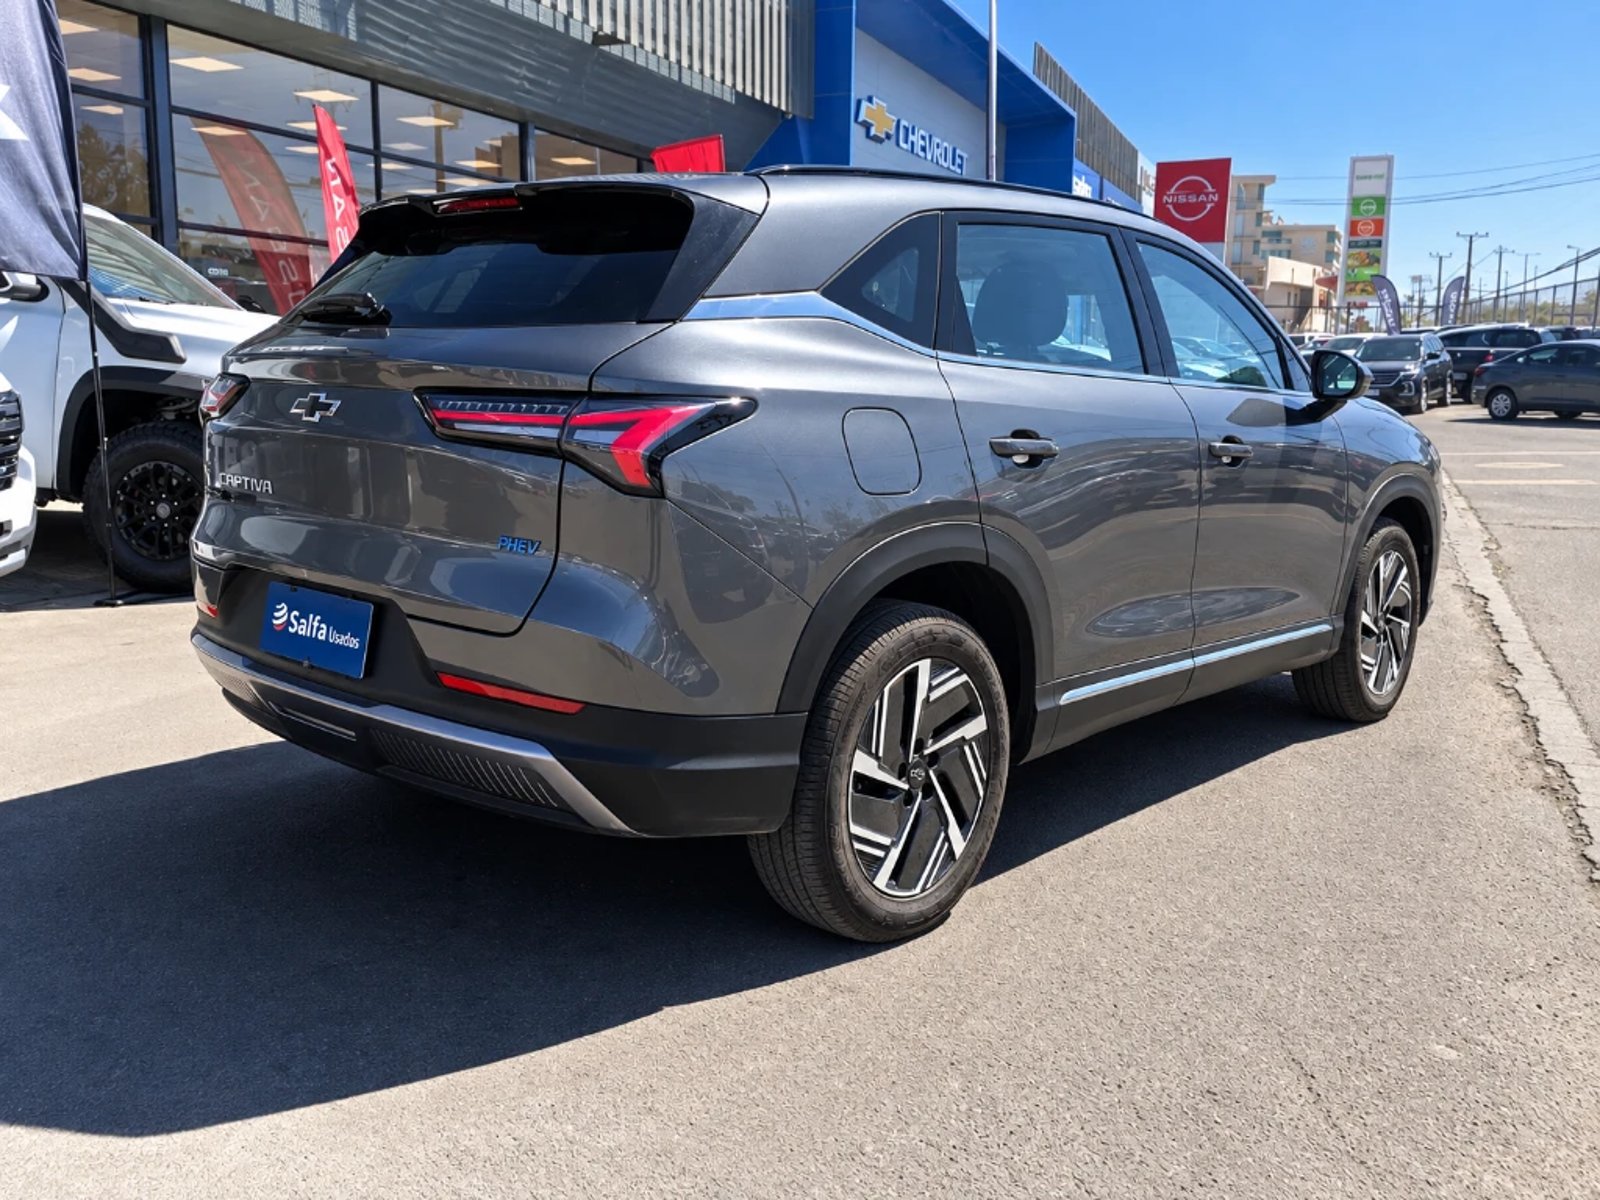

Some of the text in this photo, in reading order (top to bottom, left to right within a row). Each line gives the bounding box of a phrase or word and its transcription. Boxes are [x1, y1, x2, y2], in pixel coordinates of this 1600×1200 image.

[899, 119, 968, 175] CHEVROLET
[1162, 193, 1219, 204] NISSAN
[219, 472, 273, 494] CAPTIVA
[498, 536, 541, 555] PHEV
[288, 610, 360, 649] Salfa Usados
